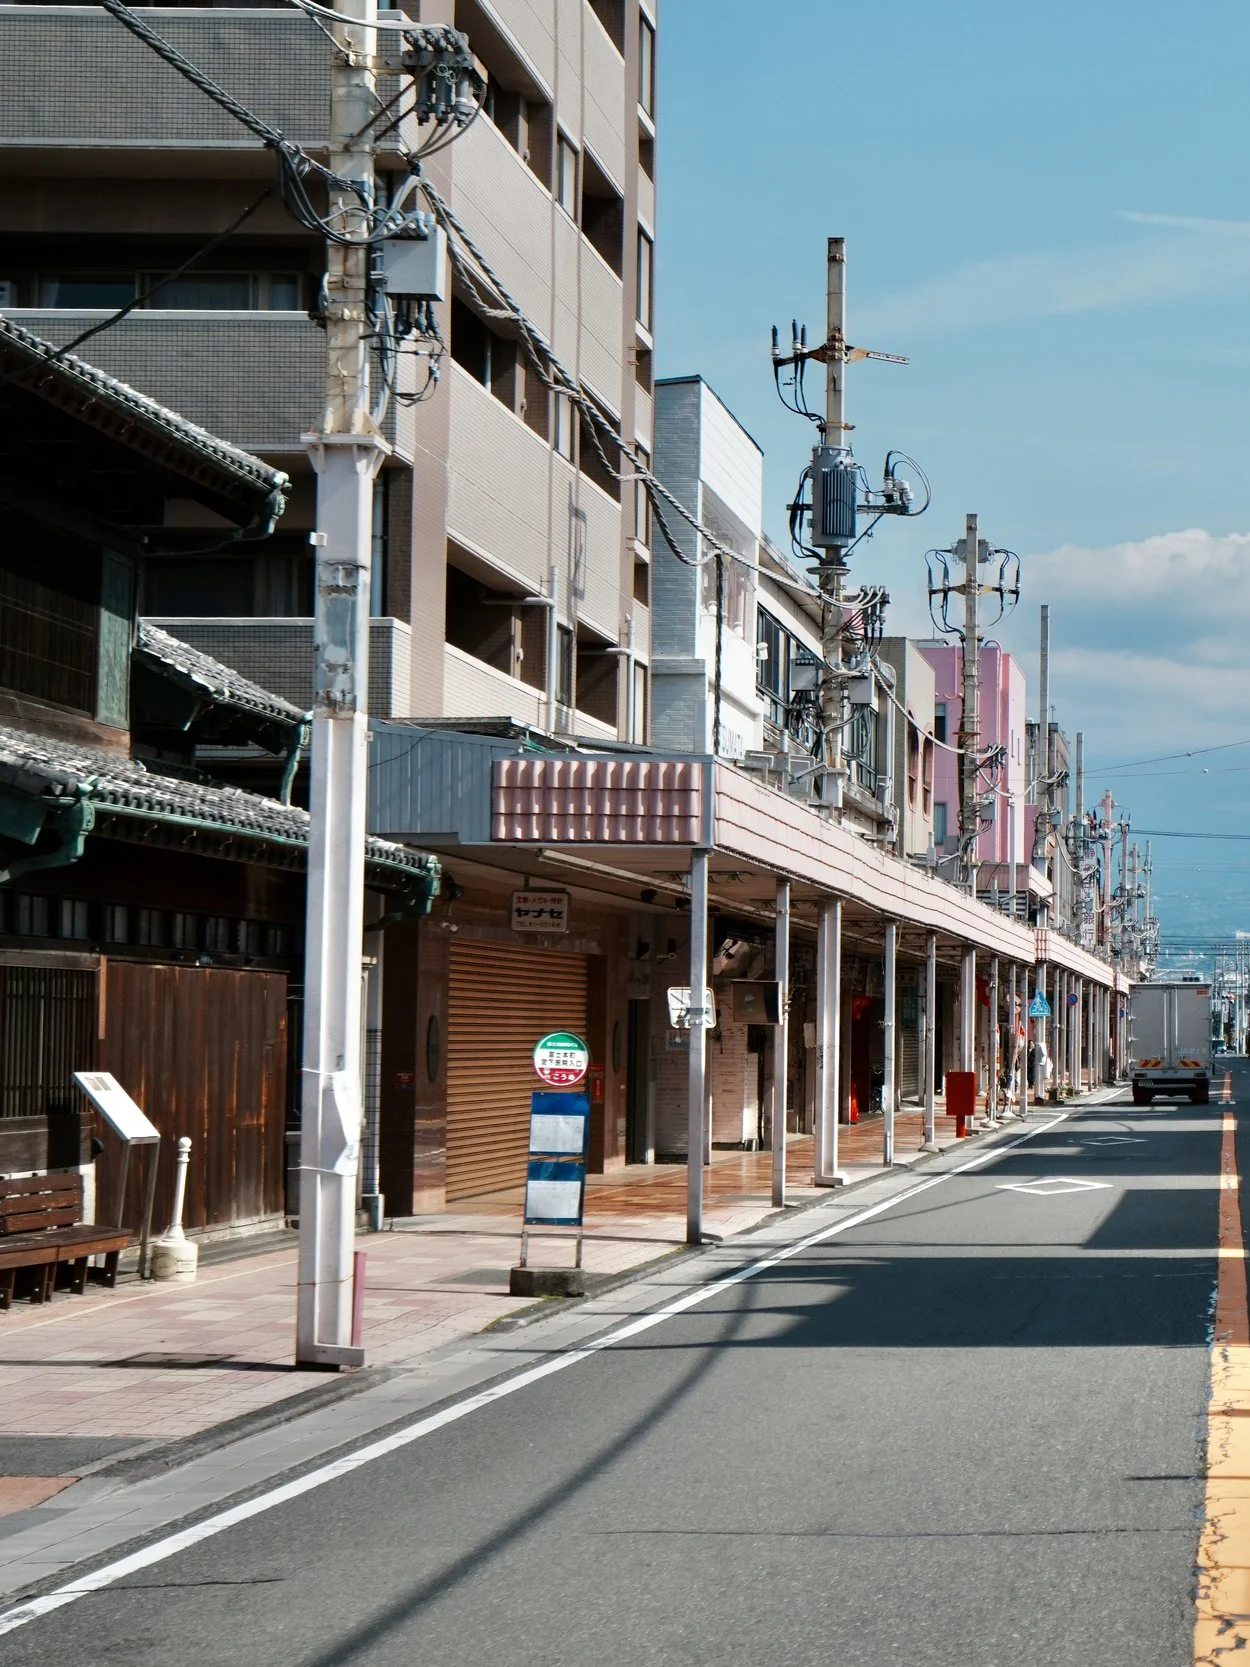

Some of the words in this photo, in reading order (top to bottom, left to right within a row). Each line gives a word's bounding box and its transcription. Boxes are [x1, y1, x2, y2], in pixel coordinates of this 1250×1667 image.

[515, 907, 563, 919] ヤナセ
[549, 1051, 576, 1059] 富士本町
